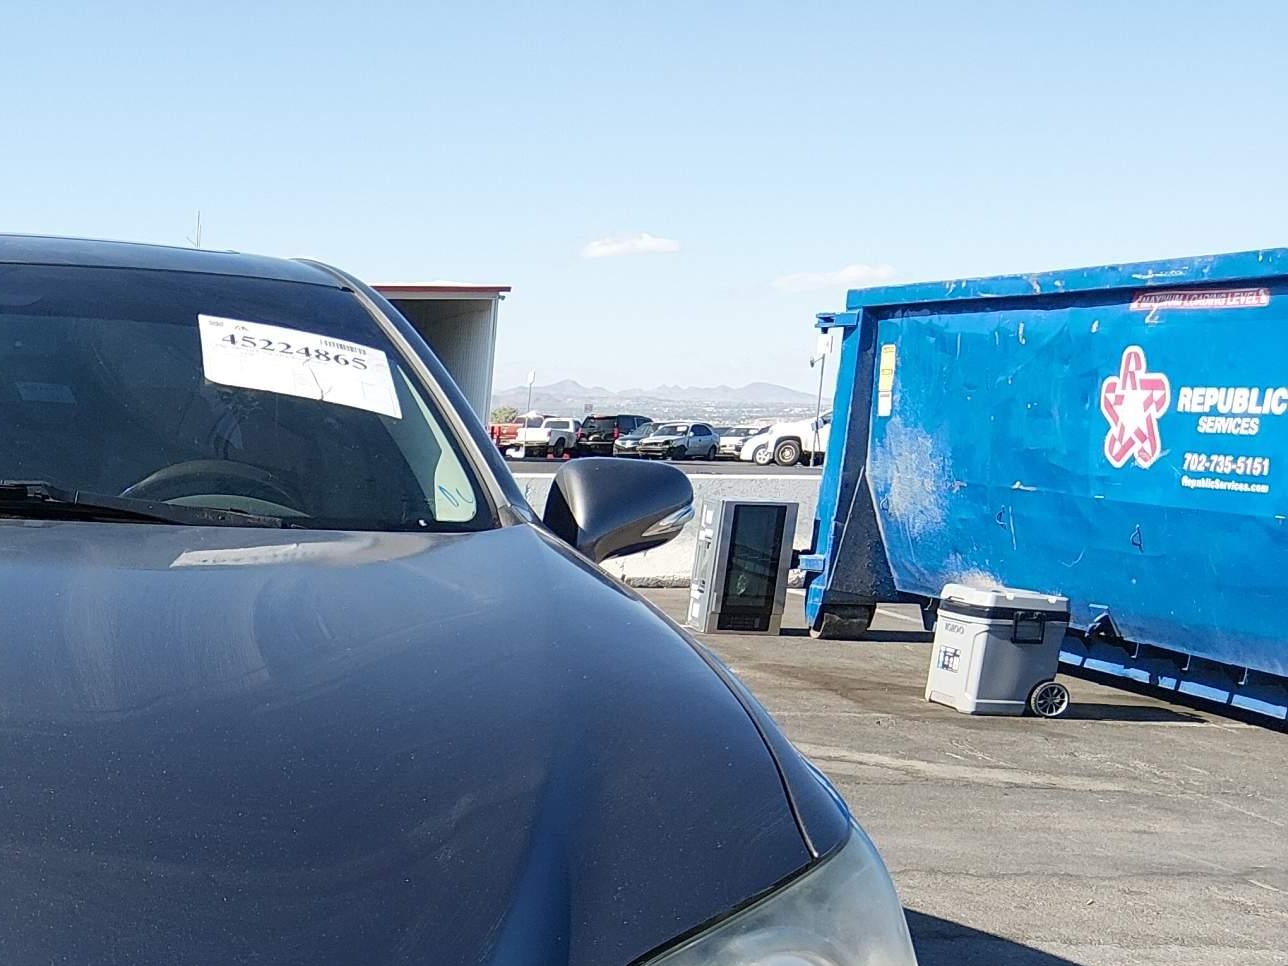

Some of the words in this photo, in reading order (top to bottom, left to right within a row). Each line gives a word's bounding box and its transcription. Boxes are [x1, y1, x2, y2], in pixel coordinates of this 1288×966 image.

[1184, 293, 1226, 305] LOADING
[1227, 291, 1259, 305] LEVEL
[222, 332, 368, 371] 45224865
[1177, 386, 1288, 415] REPUBLIC
[1197, 416, 1260, 436] SERVICES
[1182, 453, 1270, 476] 702-735-5151
[1181, 475, 1270, 493] RepublicServices.com
